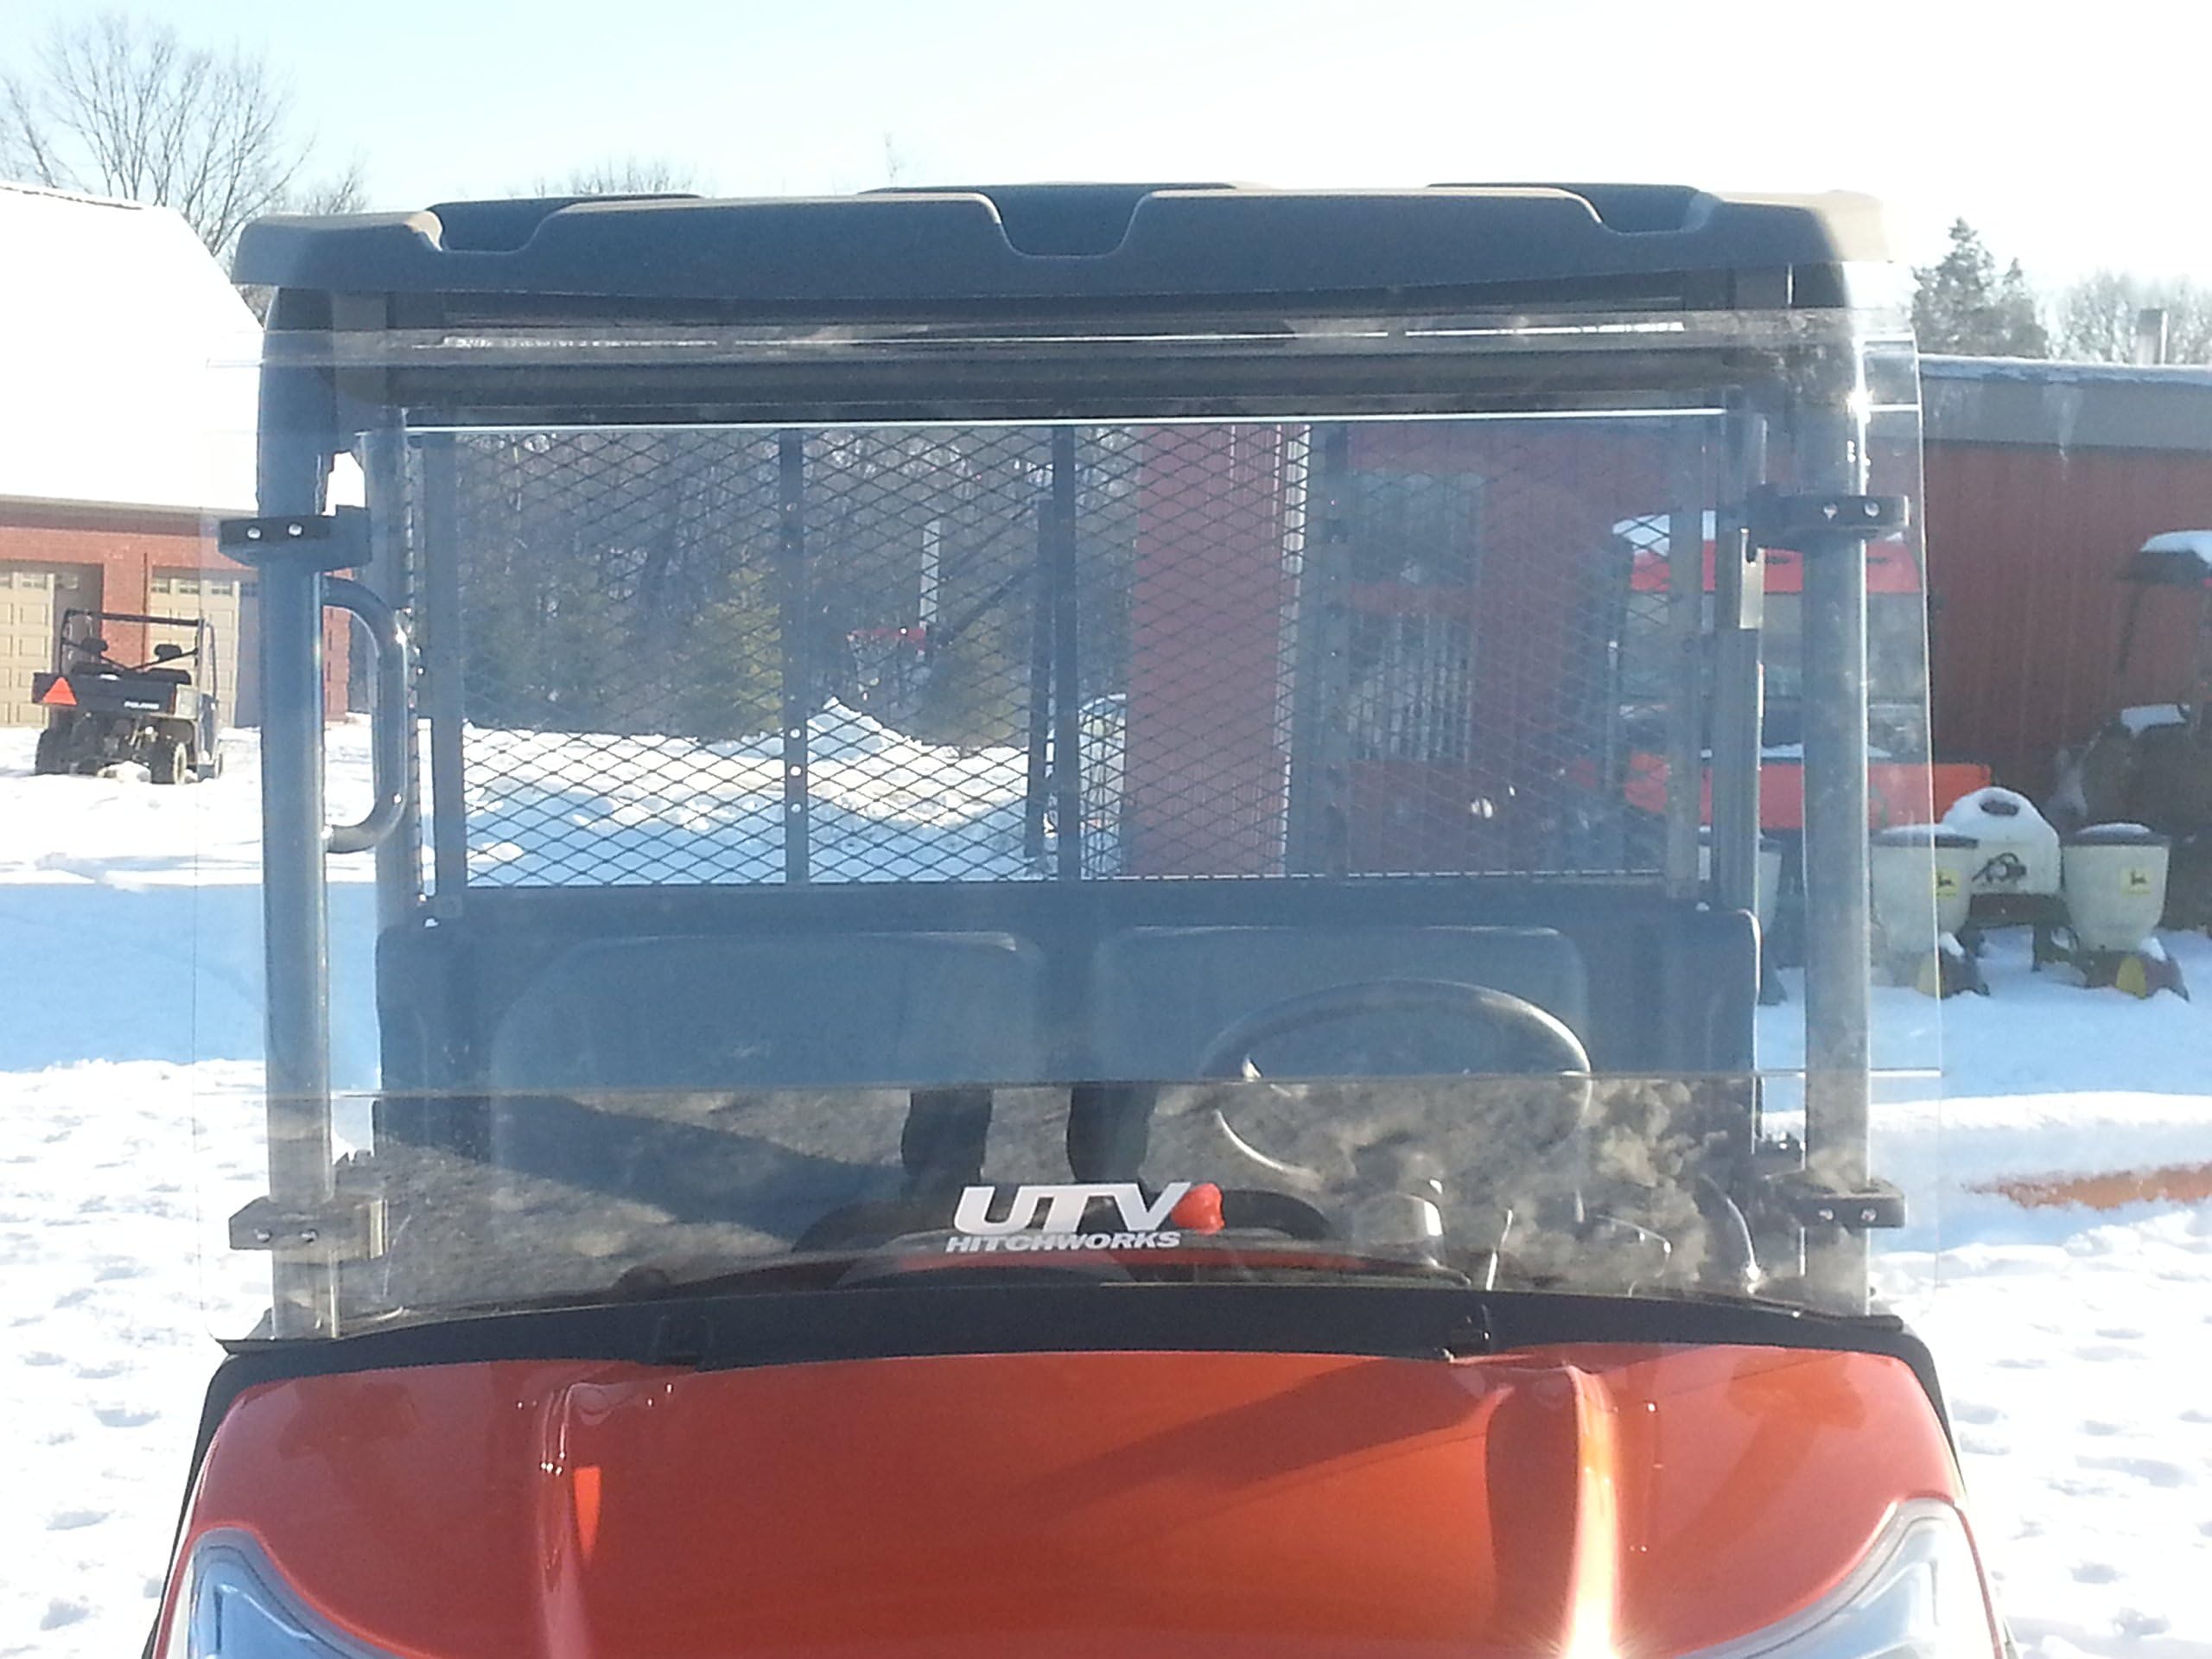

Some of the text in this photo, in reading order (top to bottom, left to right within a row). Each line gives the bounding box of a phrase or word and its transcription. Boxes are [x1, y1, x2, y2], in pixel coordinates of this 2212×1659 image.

[124, 700, 160, 710] POLA
[953, 1181, 1192, 1235] UTV
[945, 1230, 1182, 1254] HITCHWORKS
